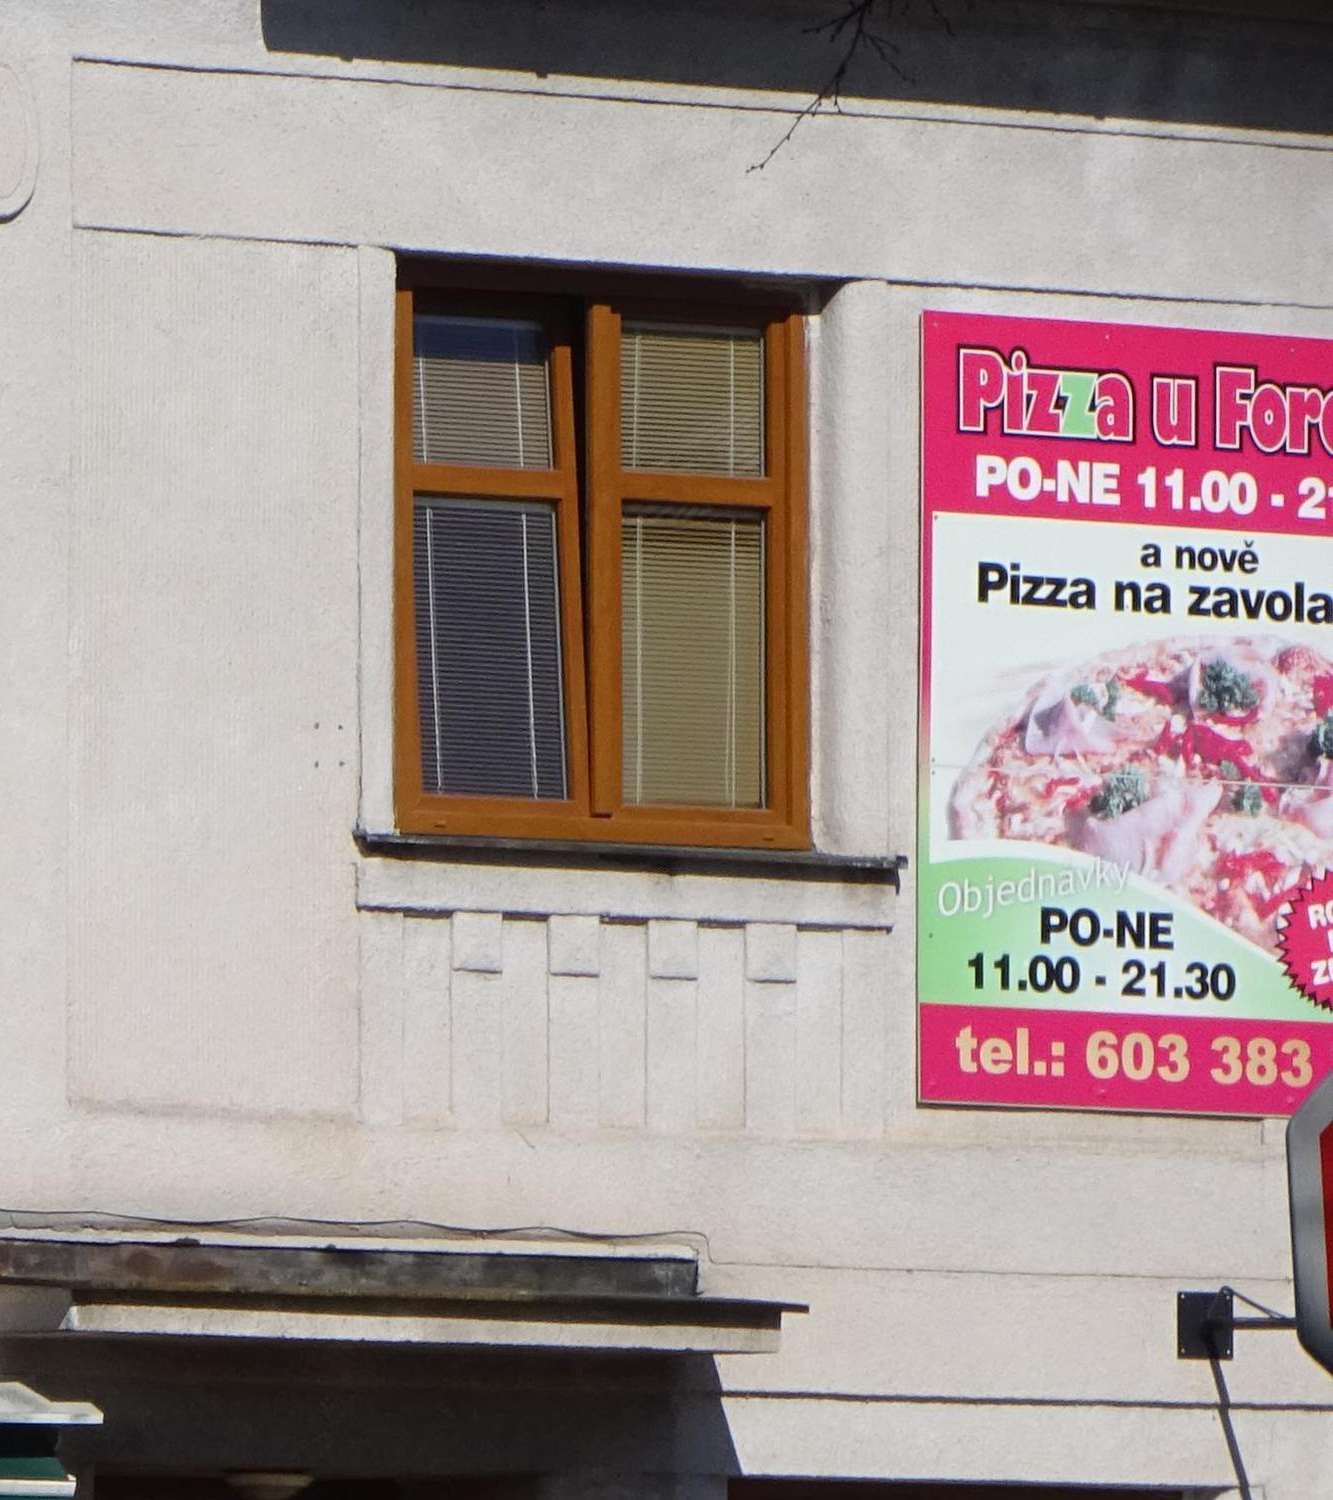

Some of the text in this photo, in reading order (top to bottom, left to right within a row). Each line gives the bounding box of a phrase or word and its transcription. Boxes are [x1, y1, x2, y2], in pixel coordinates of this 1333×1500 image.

[958, 345, 1135, 443] Pizza
[1151, 374, 1197, 446] u
[975, 453, 1121, 506] PO-NE
[1137, 466, 1258, 515] 11.00
[1269, 492, 1285, 507] -
[1140, 539, 1260, 574] a nově
[976, 561, 1333, 626] Pizza na zavola
[1039, 906, 1175, 950] PO-NE
[967, 952, 1236, 1002] 11.00 - 21.30
[955, 1025, 1313, 1088] tel.: 603 383
